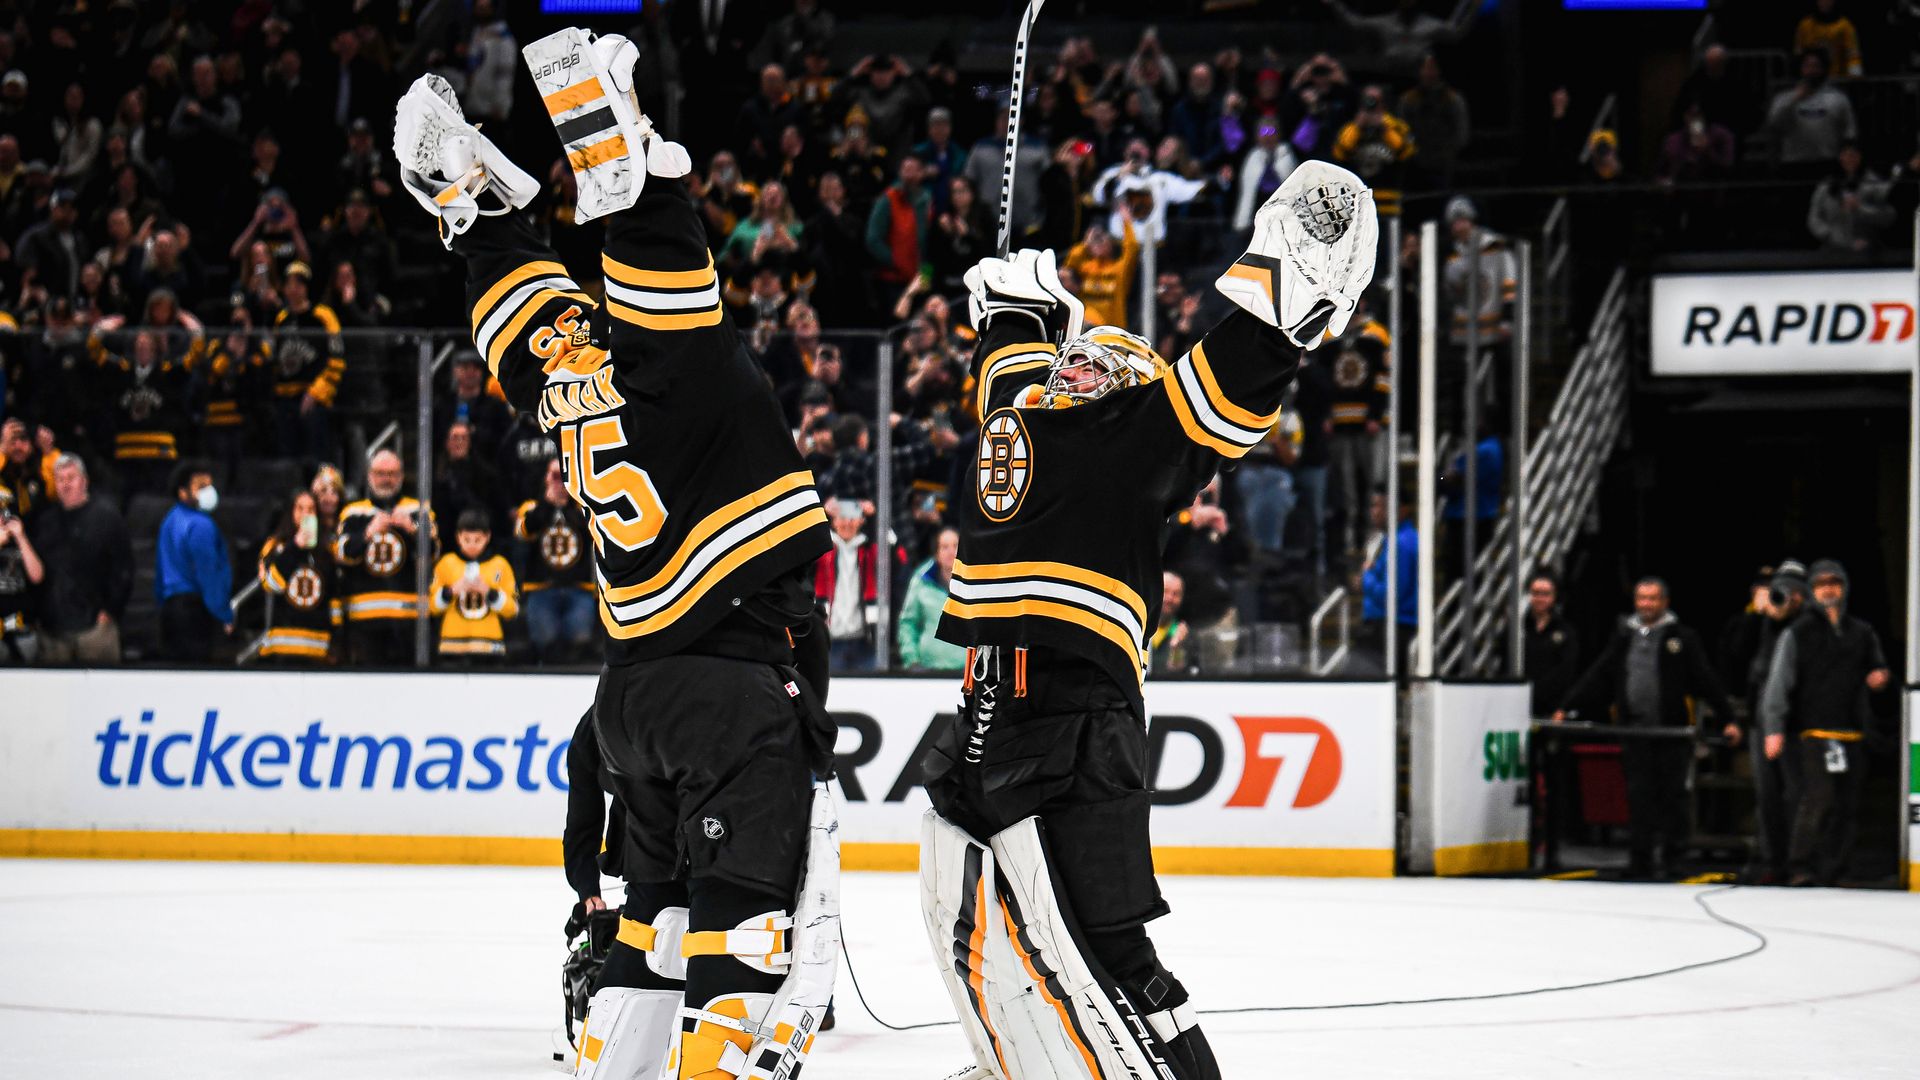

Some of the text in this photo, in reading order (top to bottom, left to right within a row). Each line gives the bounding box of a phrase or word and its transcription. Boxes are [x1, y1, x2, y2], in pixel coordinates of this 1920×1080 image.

[999, 41, 1024, 231] WARRIOR
[538, 364, 627, 433] LMARK
[1115, 986, 1179, 1080] TRUE
